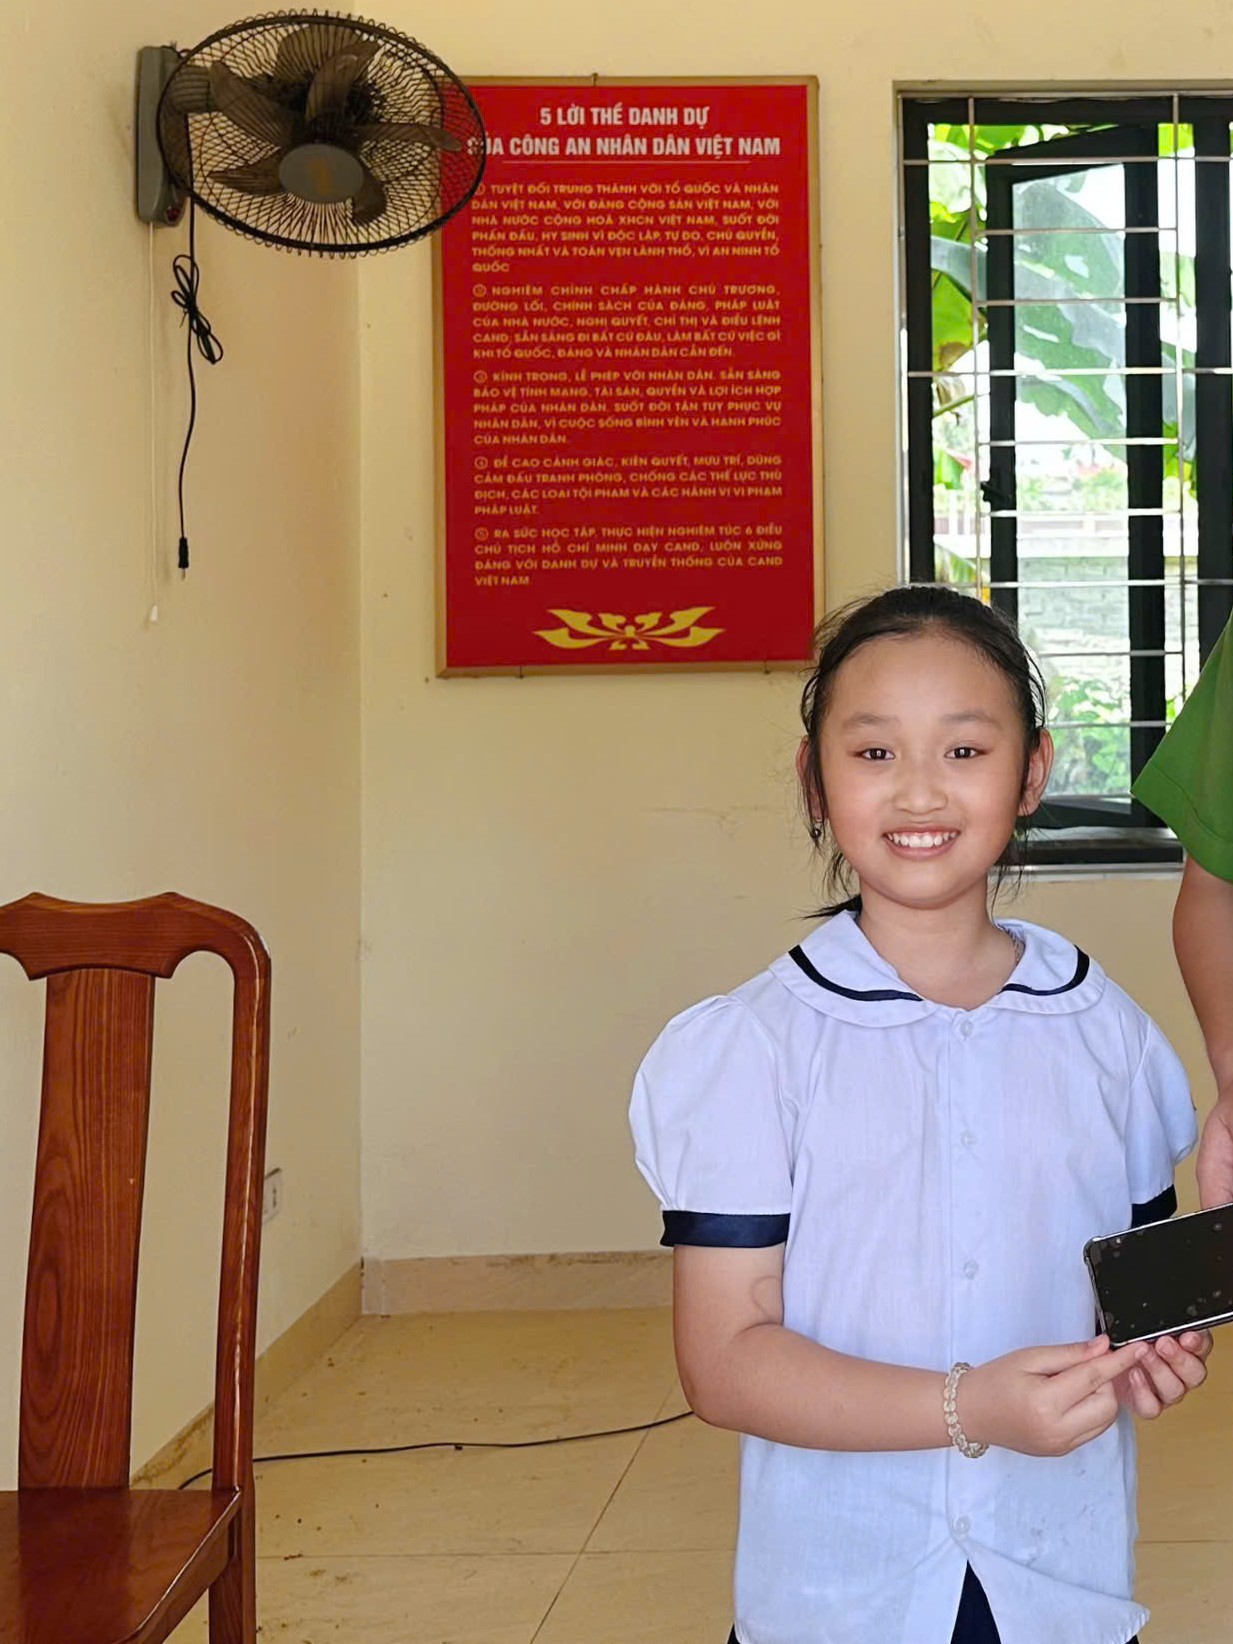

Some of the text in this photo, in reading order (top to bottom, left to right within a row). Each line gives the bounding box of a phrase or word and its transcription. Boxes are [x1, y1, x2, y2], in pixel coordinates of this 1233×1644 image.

[539, 102, 710, 129] 5 LỜI THỀ DANH DỰ
[509, 134, 560, 155] CÔNG
[565, 138, 592, 155] AN
[595, 134, 648, 155] NHÂN
[652, 134, 691, 155] DÂN
[694, 134, 734, 159] VIỆT
[737, 138, 781, 155] NAM
